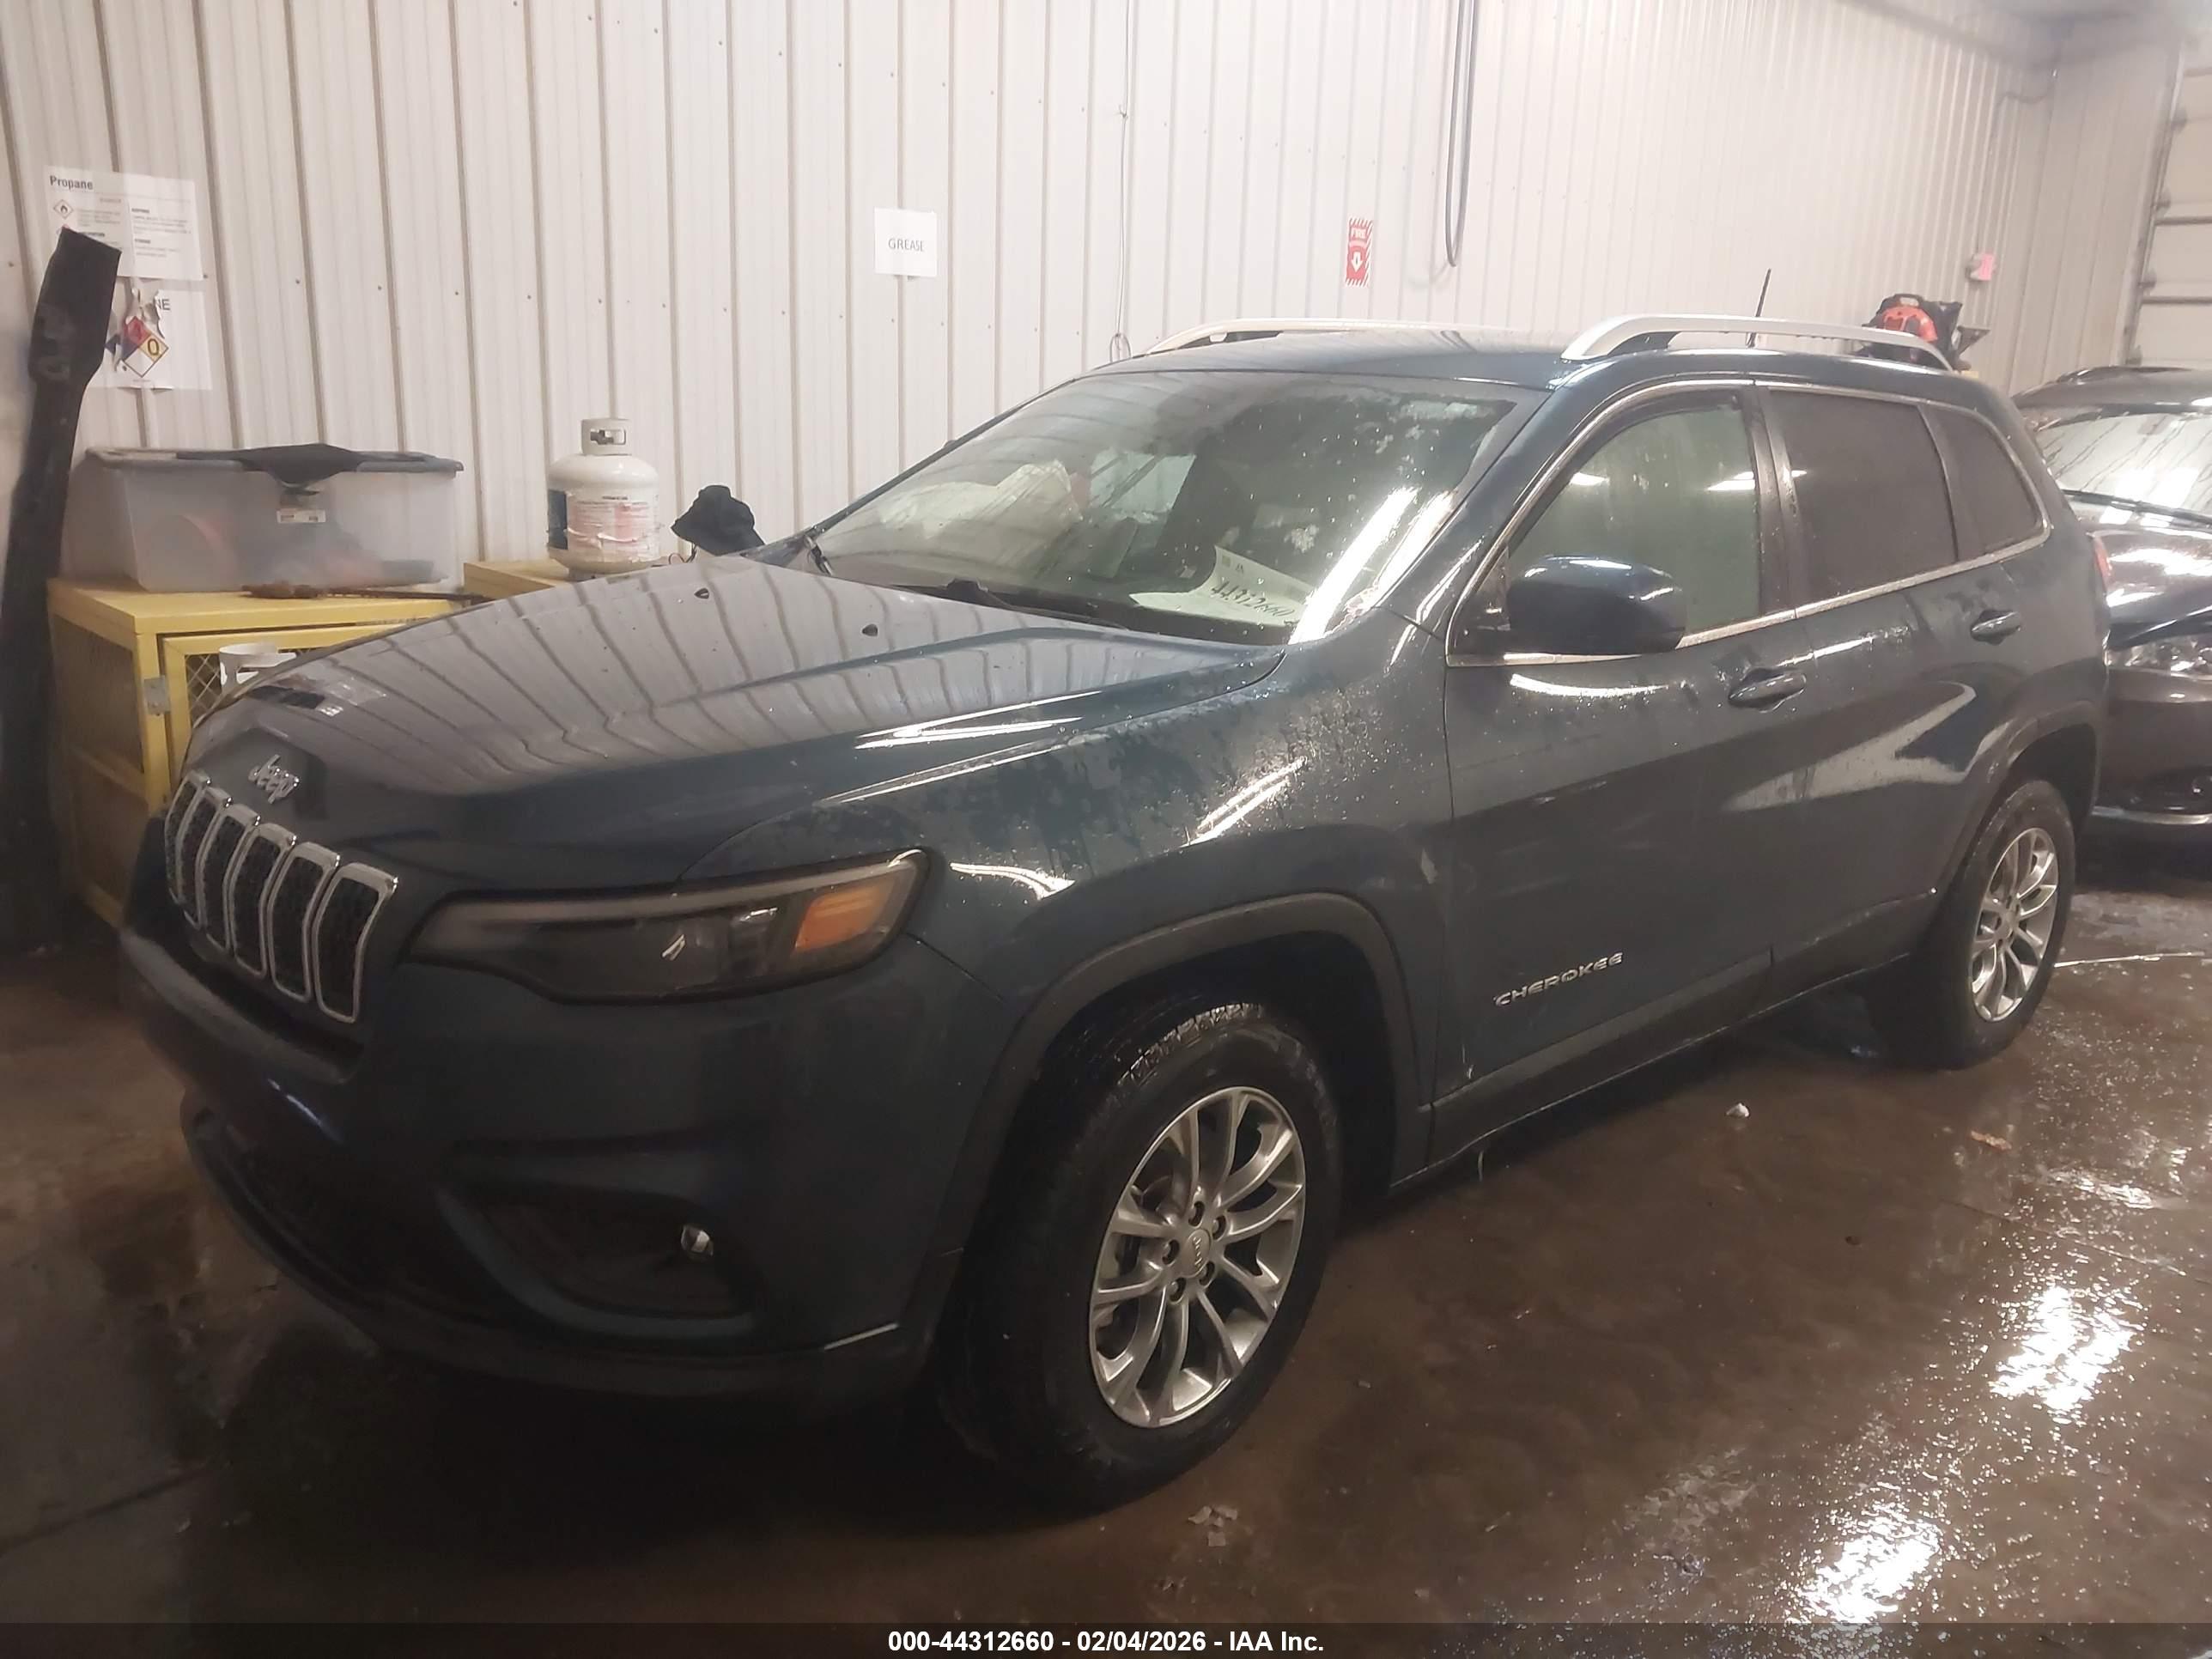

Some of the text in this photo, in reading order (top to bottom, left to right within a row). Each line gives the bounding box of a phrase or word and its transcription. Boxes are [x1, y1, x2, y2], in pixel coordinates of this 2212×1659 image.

[50, 175, 94, 190] Propane
[888, 238, 925, 252] GREASE
[248, 754, 300, 804] Jeep
[1495, 951, 1623, 1006] CHEROKEE
